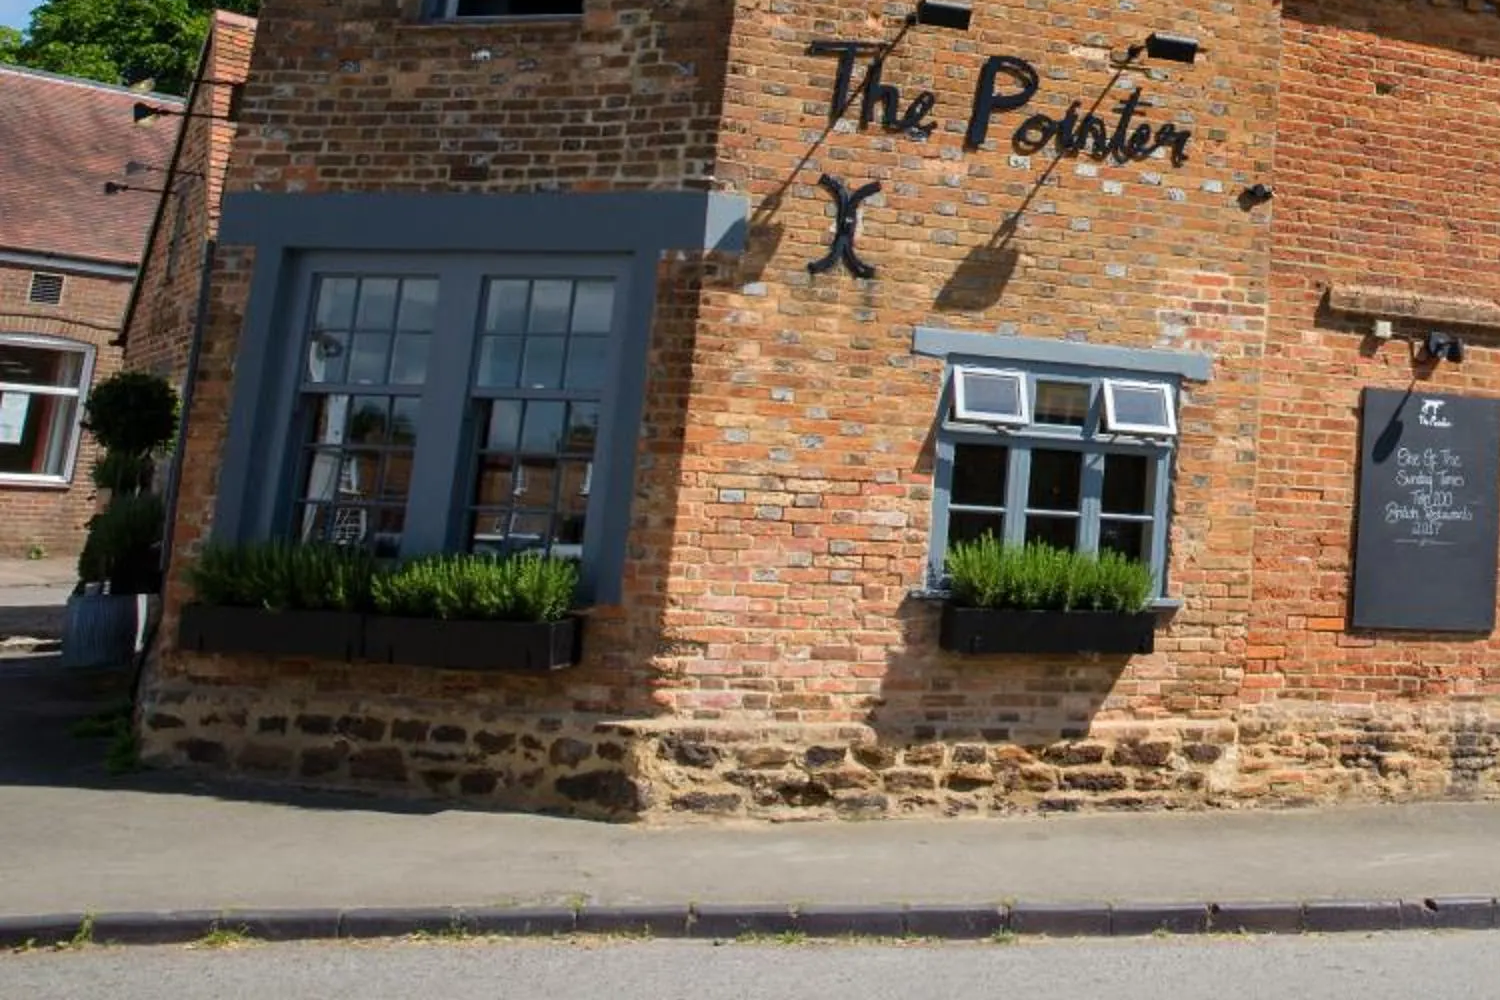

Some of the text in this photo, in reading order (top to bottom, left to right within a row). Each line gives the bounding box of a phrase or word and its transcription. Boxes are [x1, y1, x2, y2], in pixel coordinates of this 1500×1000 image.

[804, 40, 1192, 168] The Pointer
[1395, 469, 1465, 496] Sunday Times
